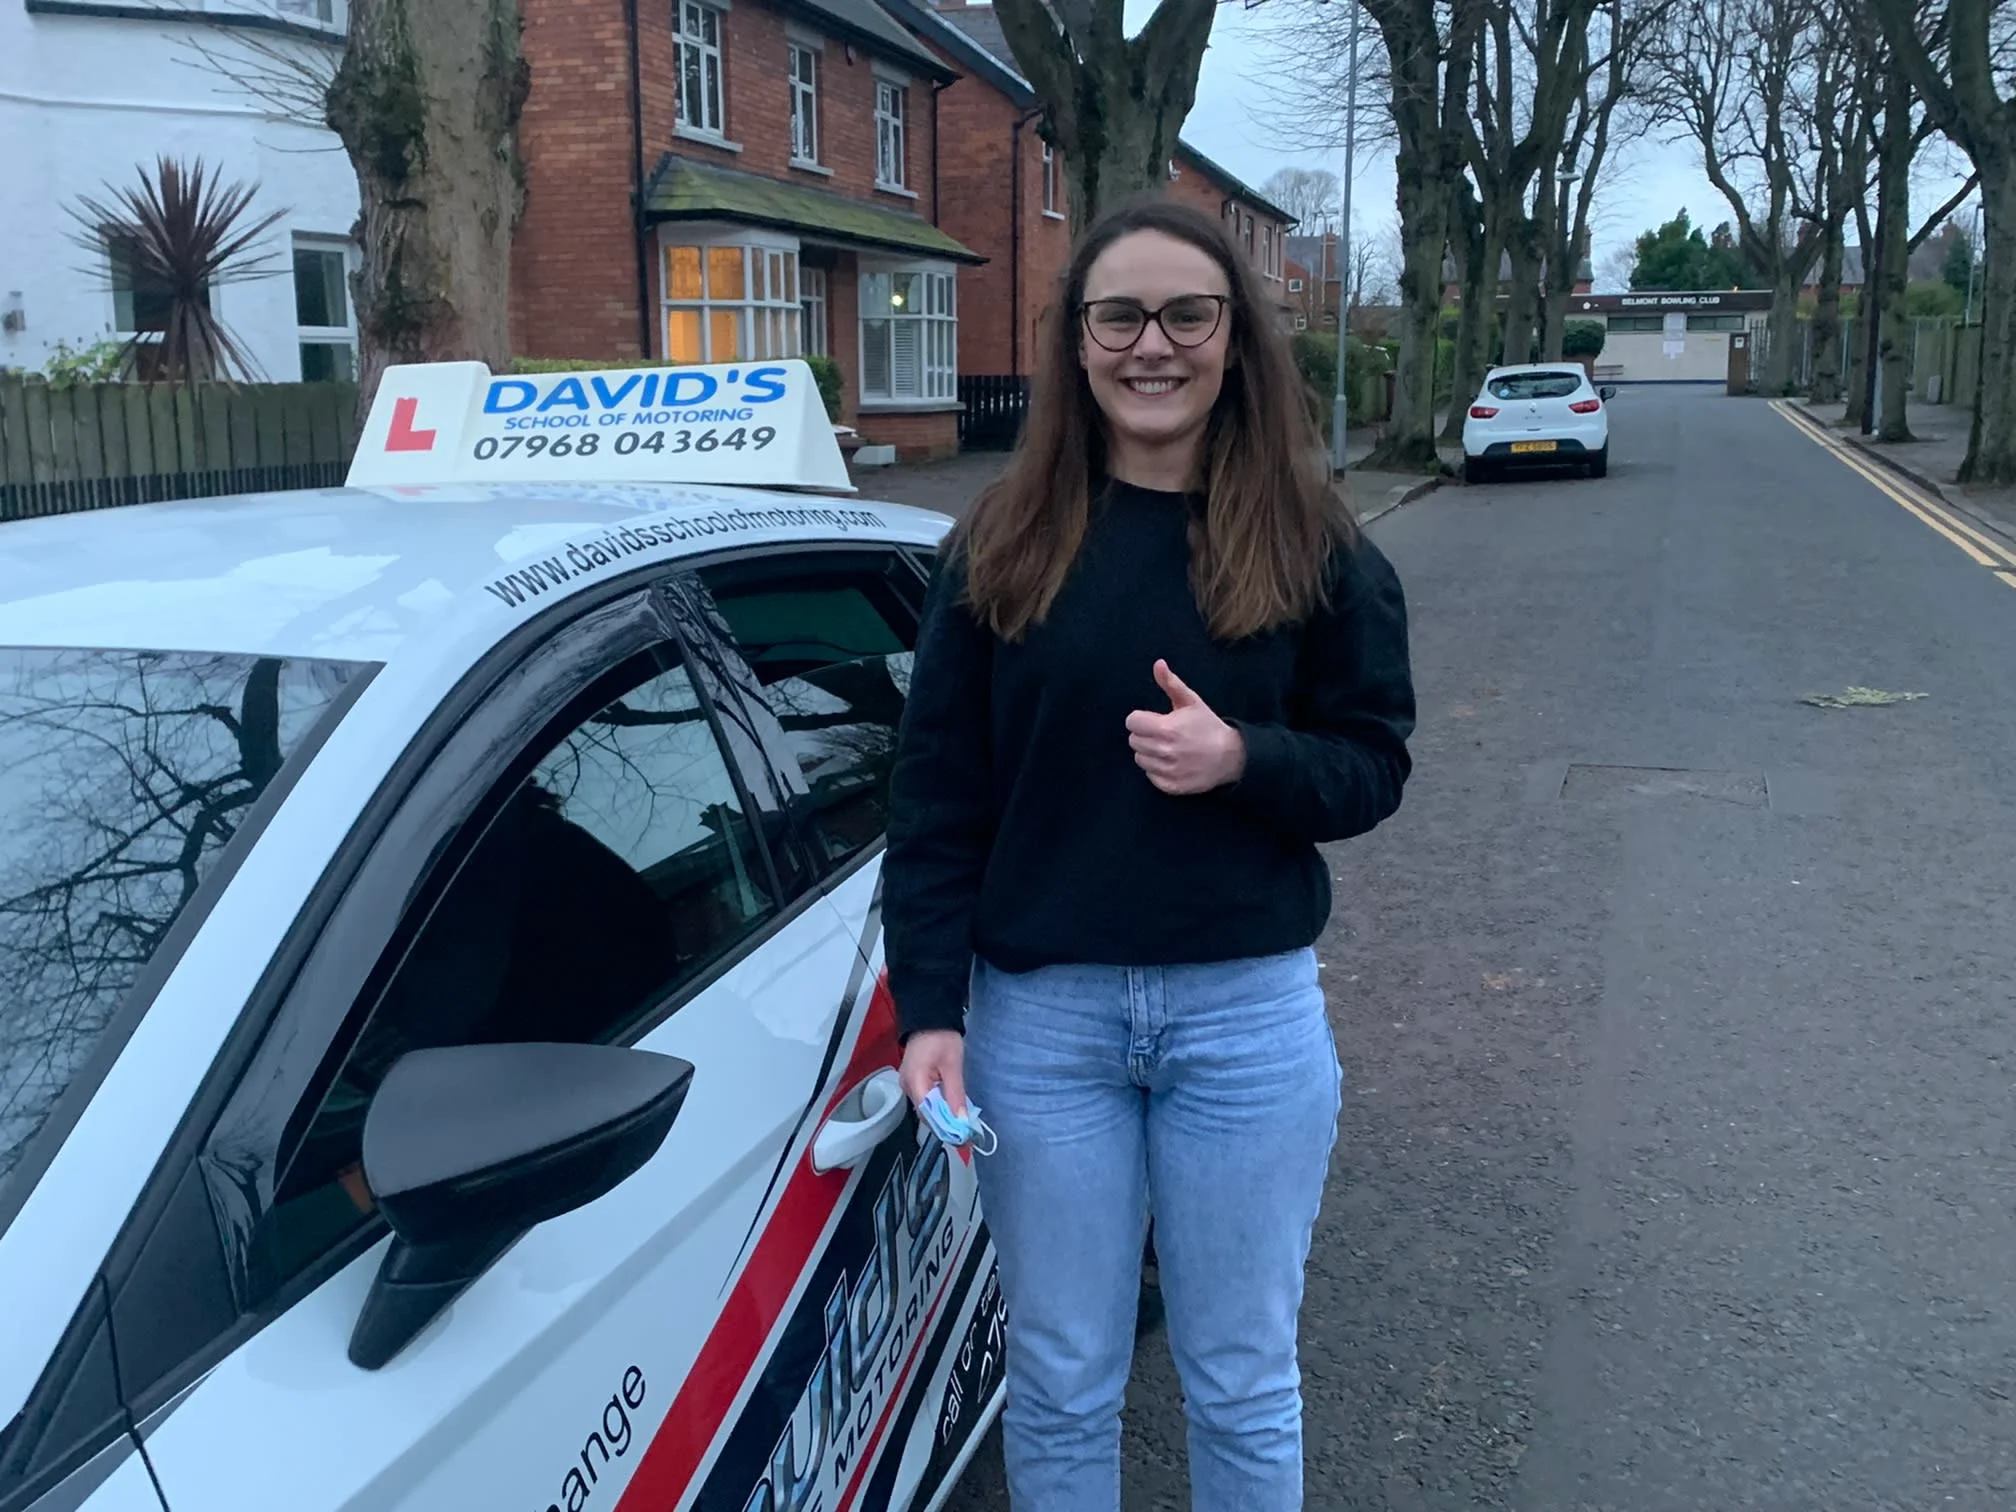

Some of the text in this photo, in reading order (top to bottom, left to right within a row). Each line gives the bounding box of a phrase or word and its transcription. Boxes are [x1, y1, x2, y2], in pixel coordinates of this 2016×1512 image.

[1621, 296, 1720, 306] BELMONT BOWLING CLUB
[482, 367, 787, 415] DAVID'S
[383, 396, 437, 452] L
[473, 425, 776, 461] 07968 043649
[503, 407, 754, 430] SCHOOL OF MOTORING
[484, 505, 888, 609] www.davidsschoolofmotoring.com
[834, 1216, 954, 1490] MOTORING
[942, 1369, 964, 1446] call
[961, 1321, 977, 1372] or
